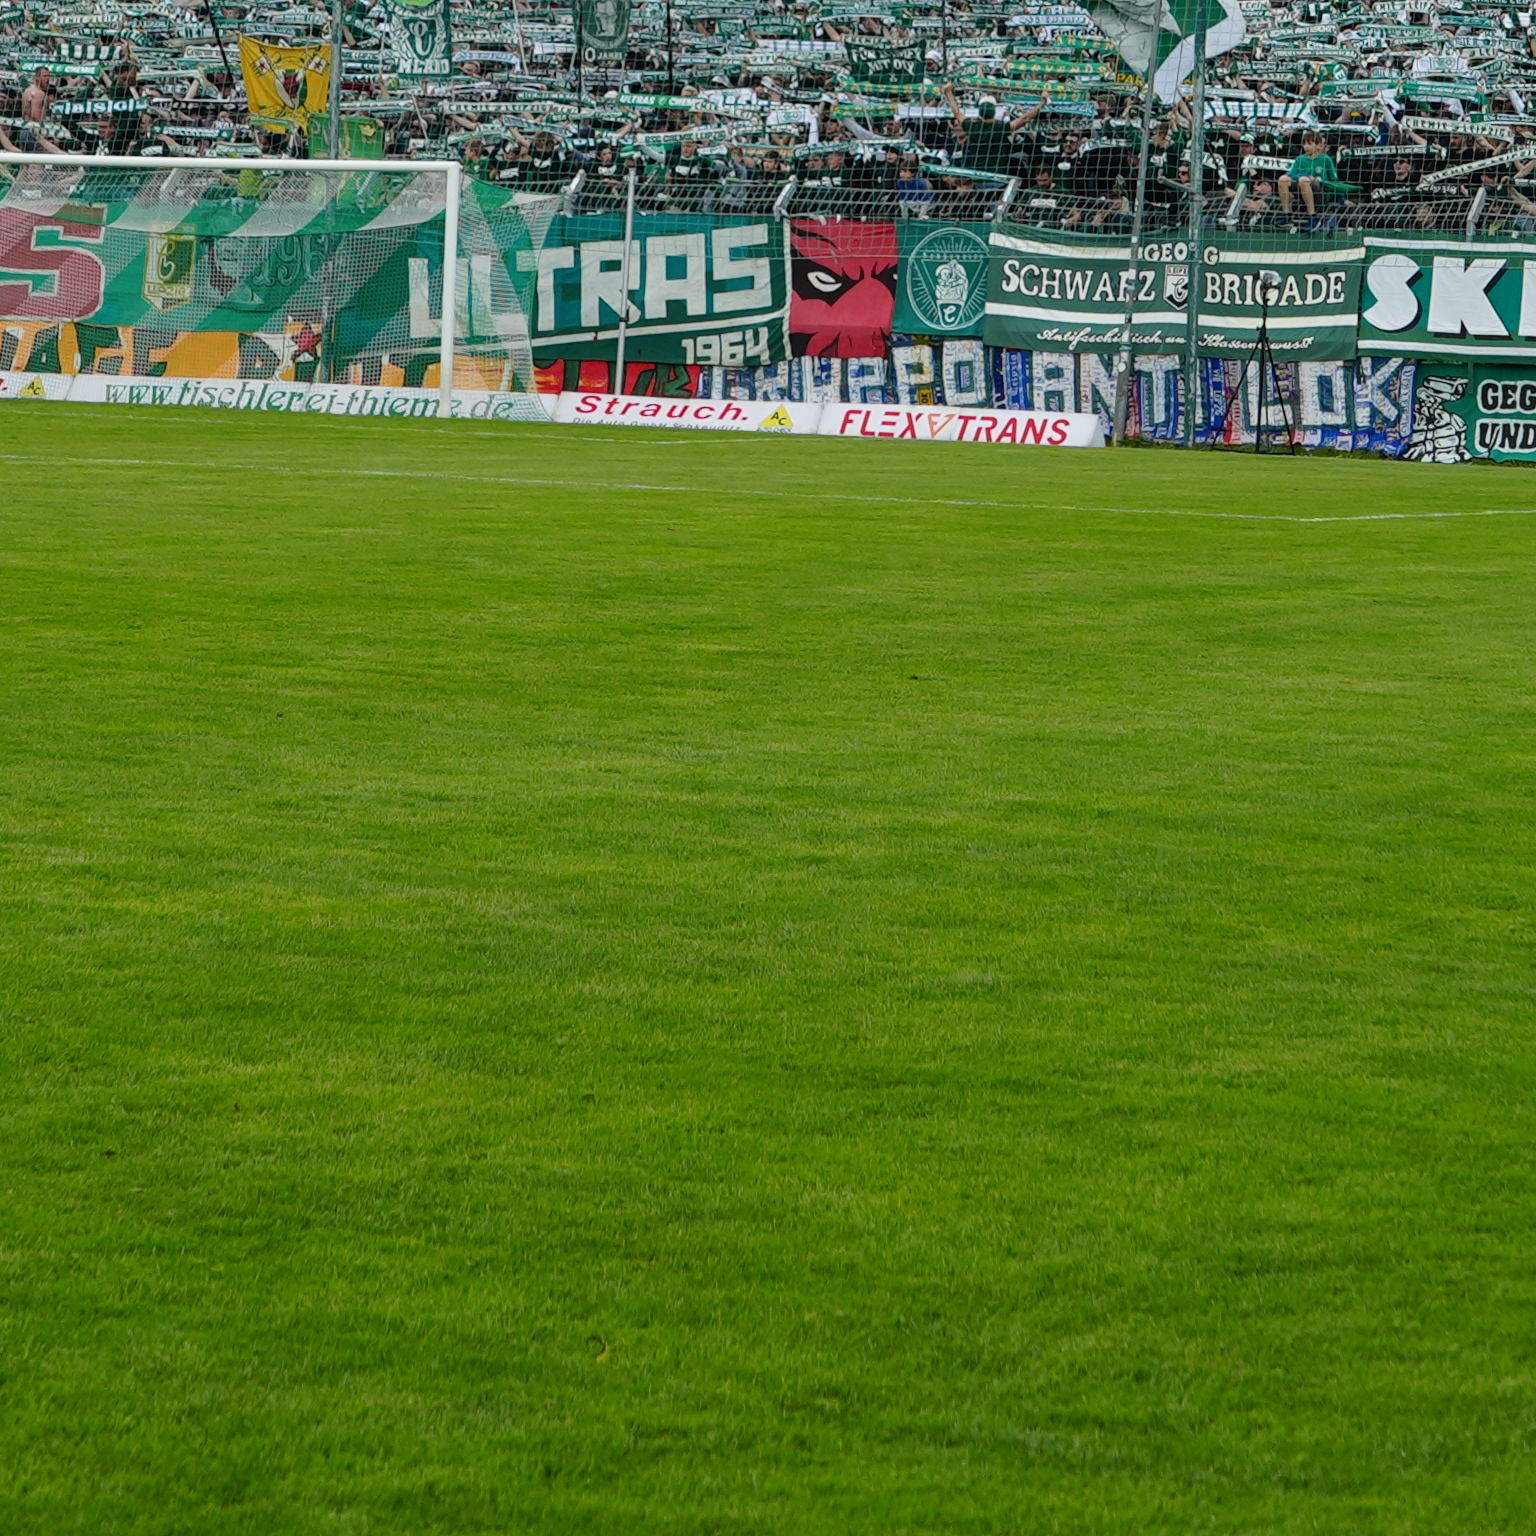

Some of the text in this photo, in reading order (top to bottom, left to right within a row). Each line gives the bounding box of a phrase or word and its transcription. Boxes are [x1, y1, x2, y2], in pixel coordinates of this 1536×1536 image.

[620, 95, 656, 105] ULTRAS
[1203, 270, 1346, 307] BRIGADE
[682, 325, 769, 367] 1964
[574, 394, 749, 422] Strauch.
